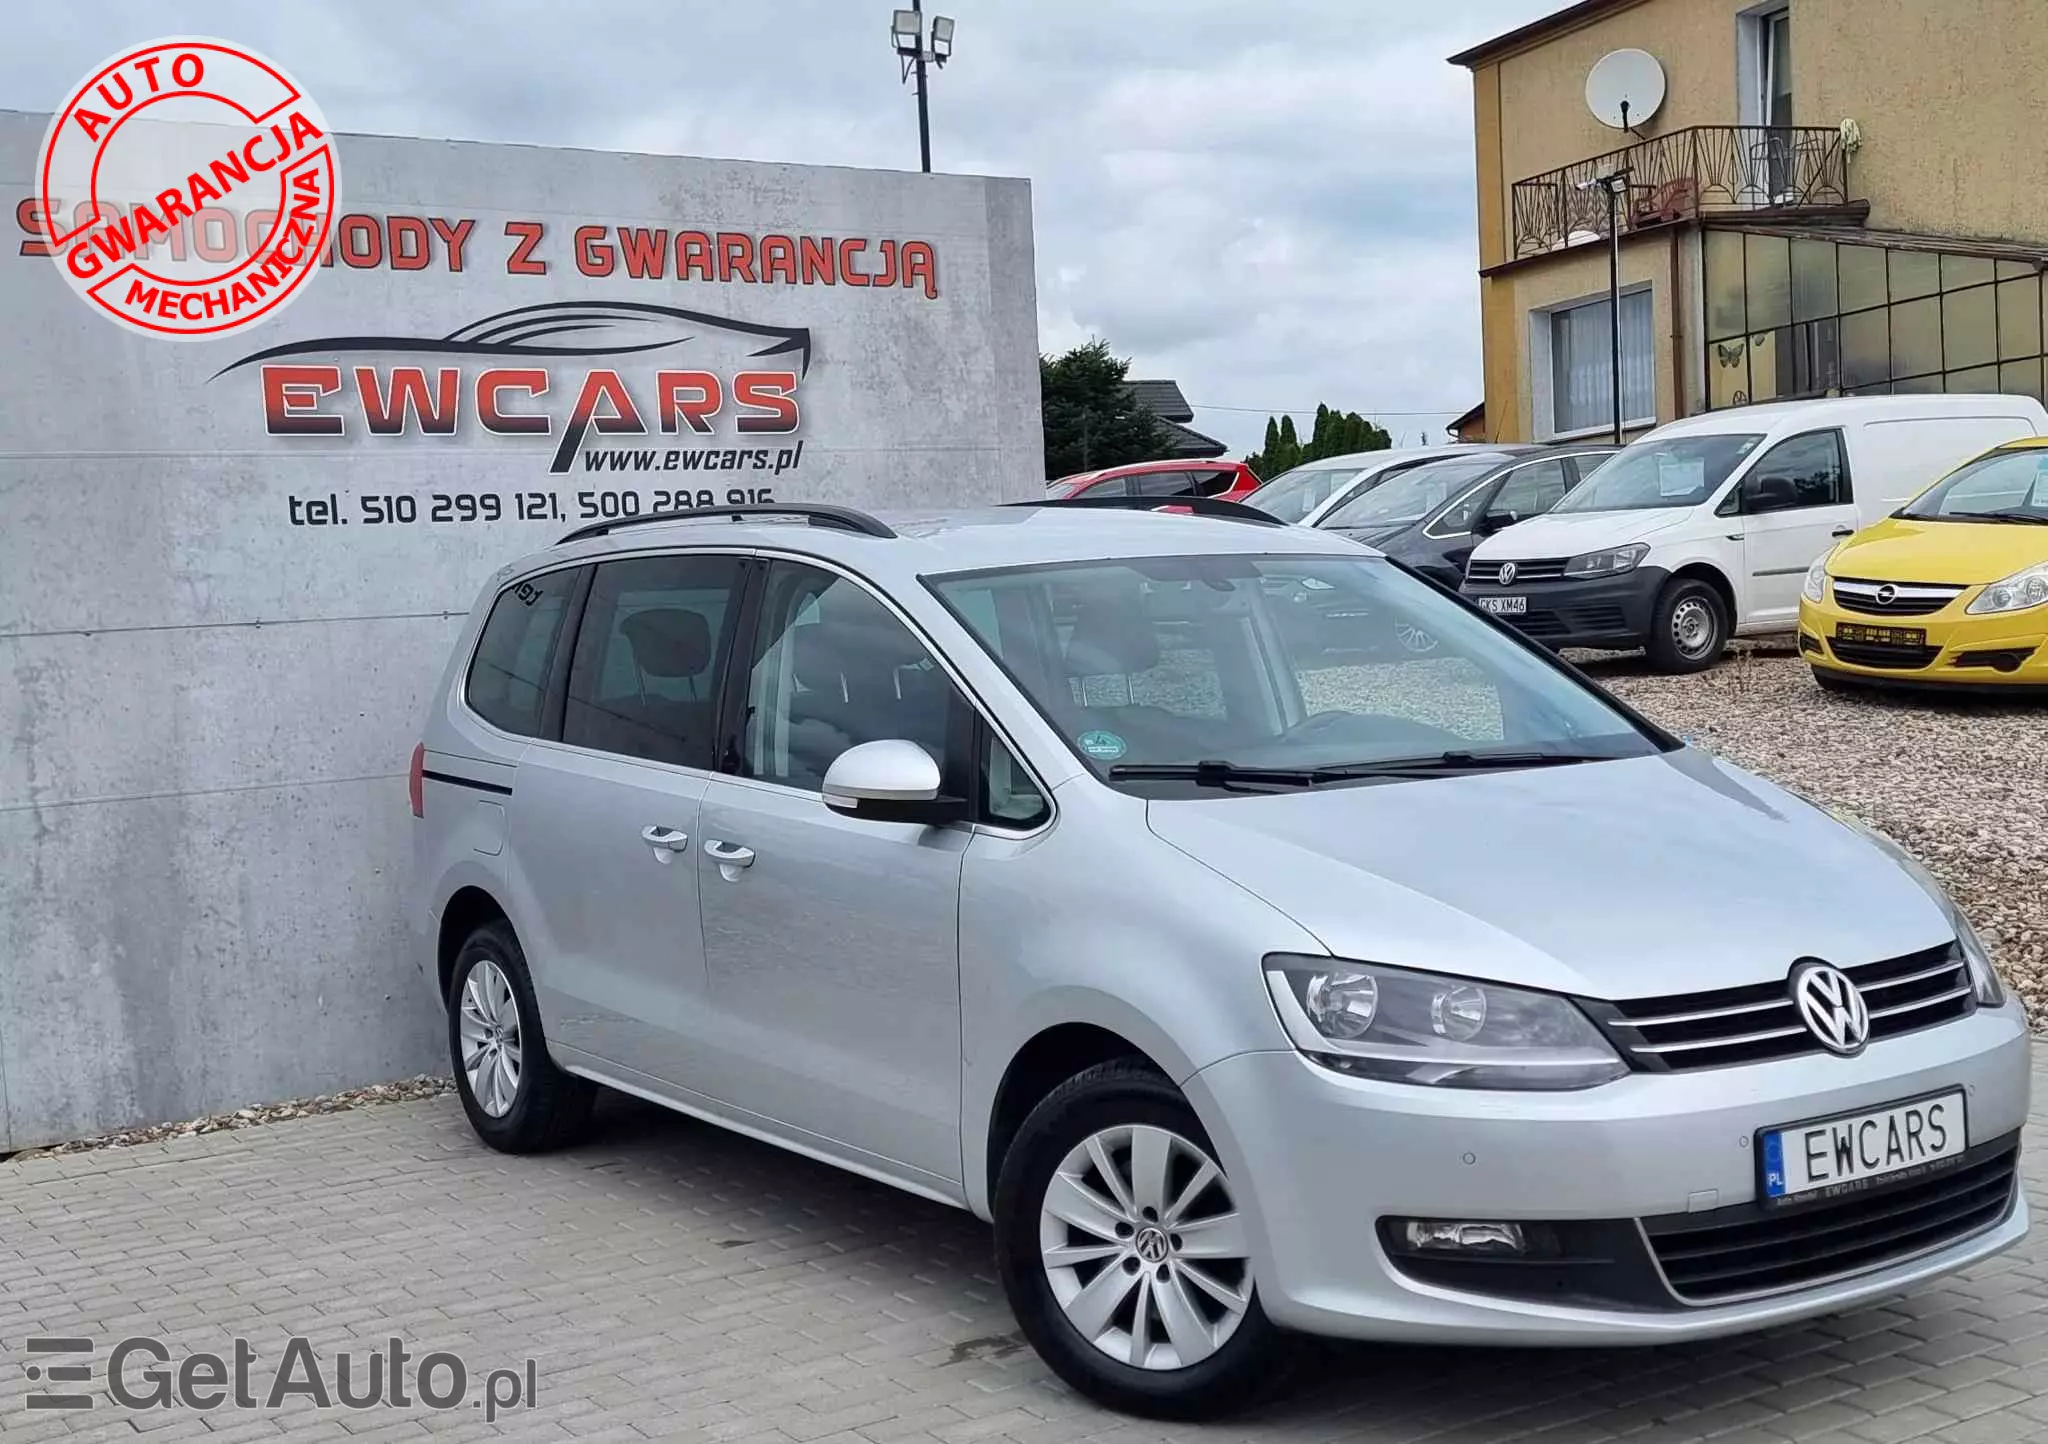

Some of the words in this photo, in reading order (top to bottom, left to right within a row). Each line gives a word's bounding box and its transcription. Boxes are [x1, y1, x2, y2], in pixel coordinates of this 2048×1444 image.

[504, 221, 547, 275] Z
[574, 226, 938, 300] GWARANCJĄ
[260, 364, 802, 475] EWCARS
[585, 440, 804, 476] www.ewcars.pl
[288, 493, 349, 526] tel.
[360, 495, 417, 525] 510
[431, 493, 502, 523] 299
[514, 492, 567, 522] 121,
[577, 490, 640, 519] 500
[652, 489, 716, 513] 288
[1804, 1103, 1947, 1183] EWCARS
[1767, 1173, 1784, 1187] PL
